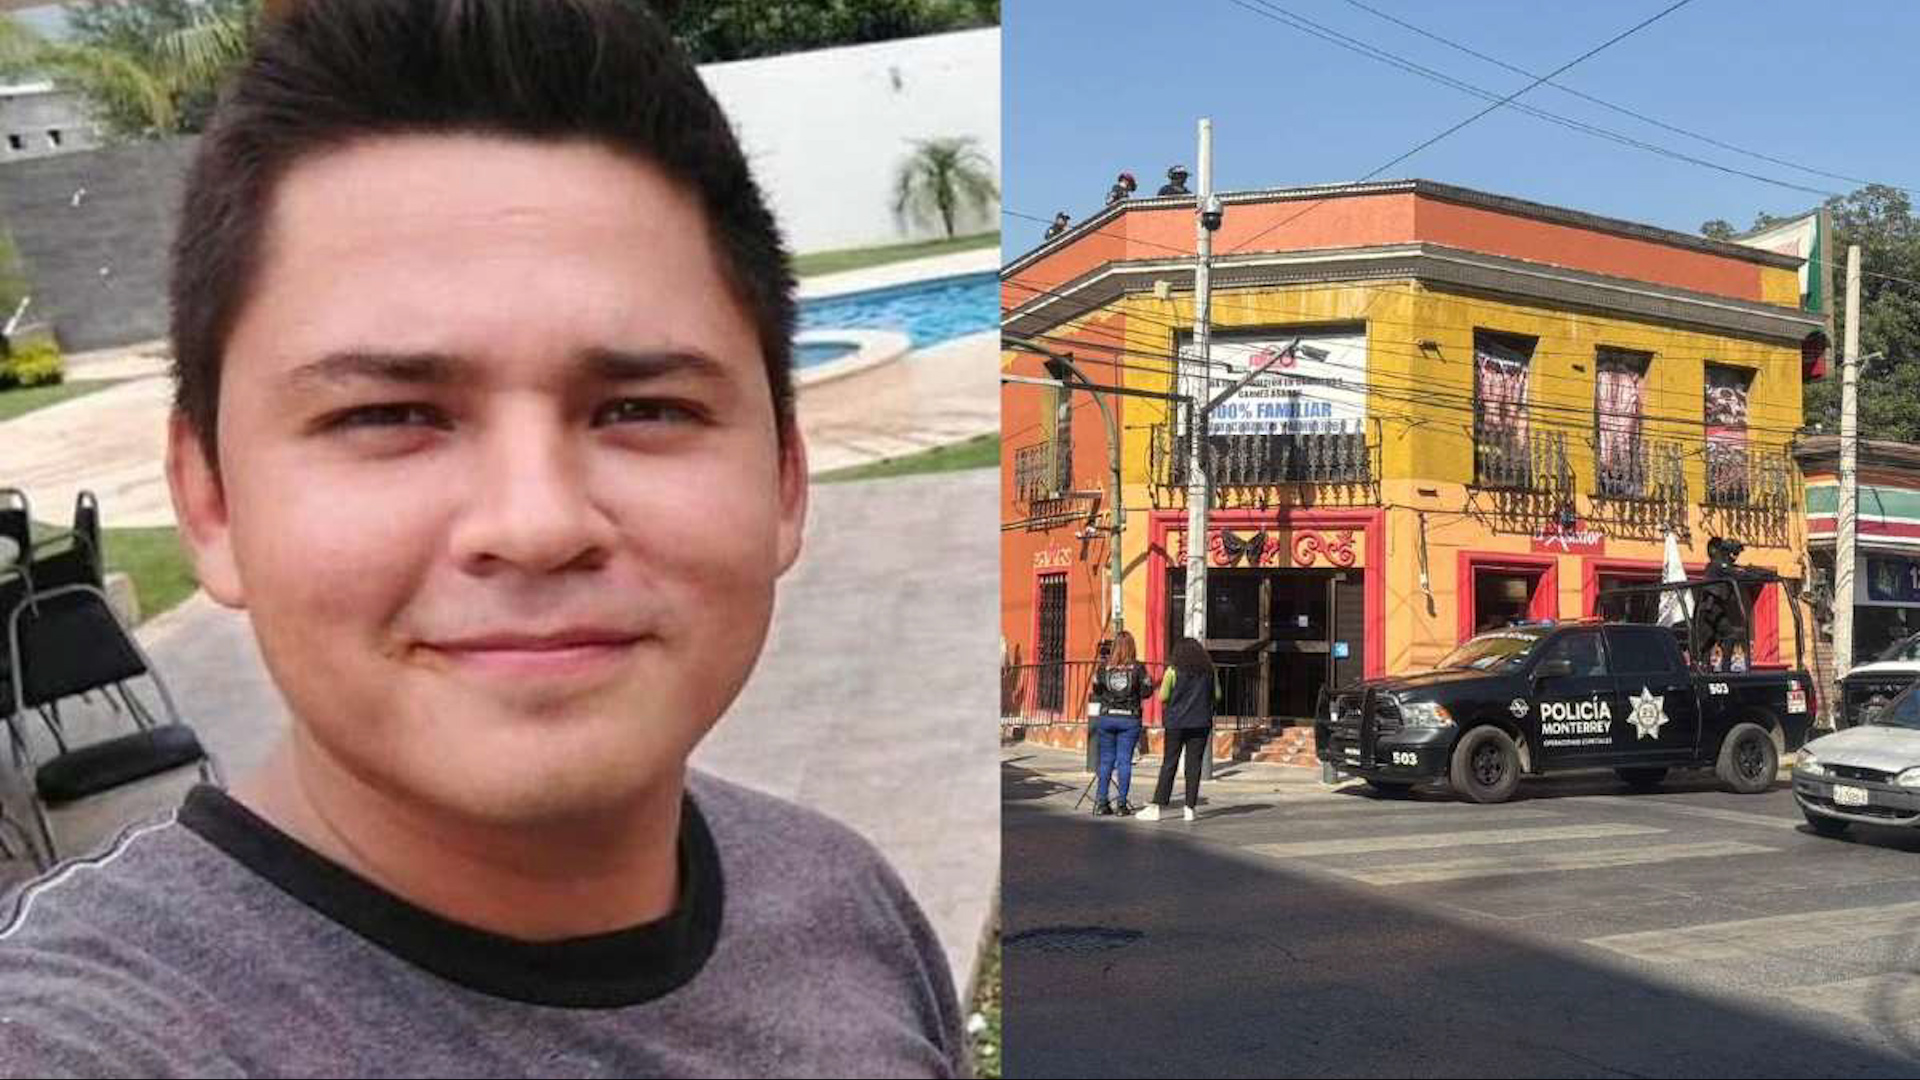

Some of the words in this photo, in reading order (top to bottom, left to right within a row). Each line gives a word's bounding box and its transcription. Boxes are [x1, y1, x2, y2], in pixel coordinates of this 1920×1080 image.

[1257, 402, 1332, 419] FAMILIAR
[1708, 682, 1730, 695] 503
[1540, 695, 1613, 722] POLICÍA
[1541, 720, 1613, 735] MONTERREY
[1392, 751, 1419, 766] 503
